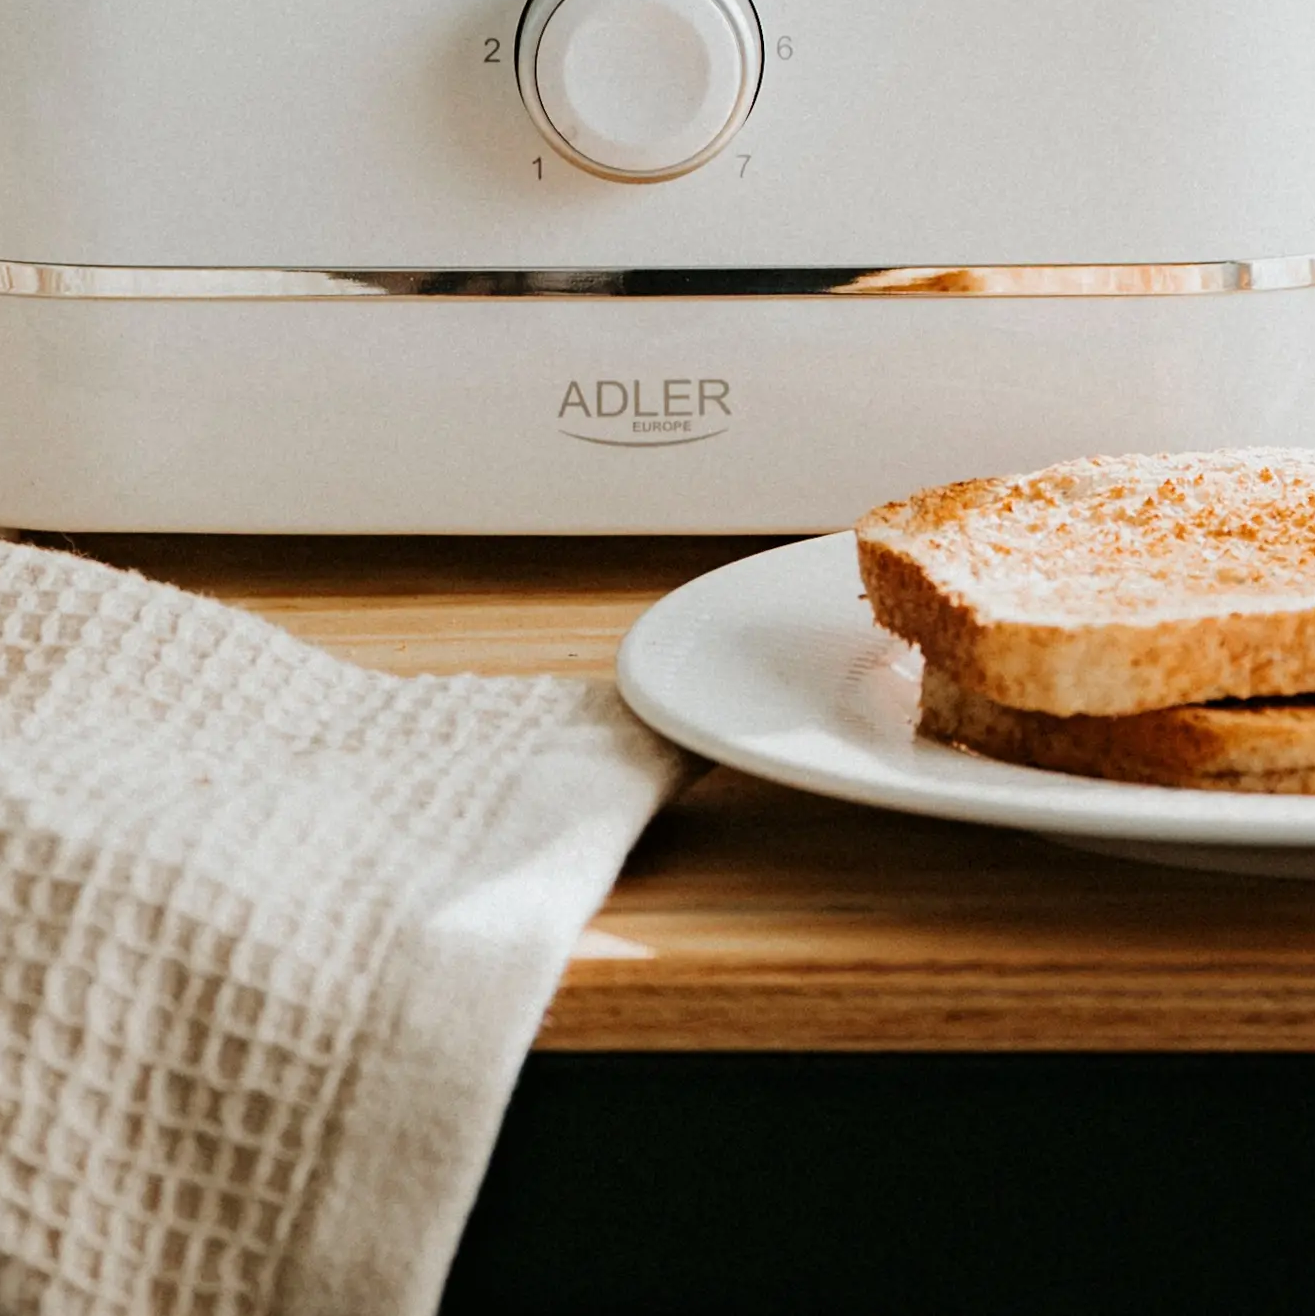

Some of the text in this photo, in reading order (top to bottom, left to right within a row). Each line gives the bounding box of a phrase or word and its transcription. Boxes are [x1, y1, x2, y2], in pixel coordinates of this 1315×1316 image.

[483, 37, 501, 64] 2
[776, 35, 794, 61] 6
[531, 156, 543, 181] 1
[736, 153, 752, 179] 7
[557, 379, 732, 418] ADLER
[632, 420, 692, 433] EUROPE
